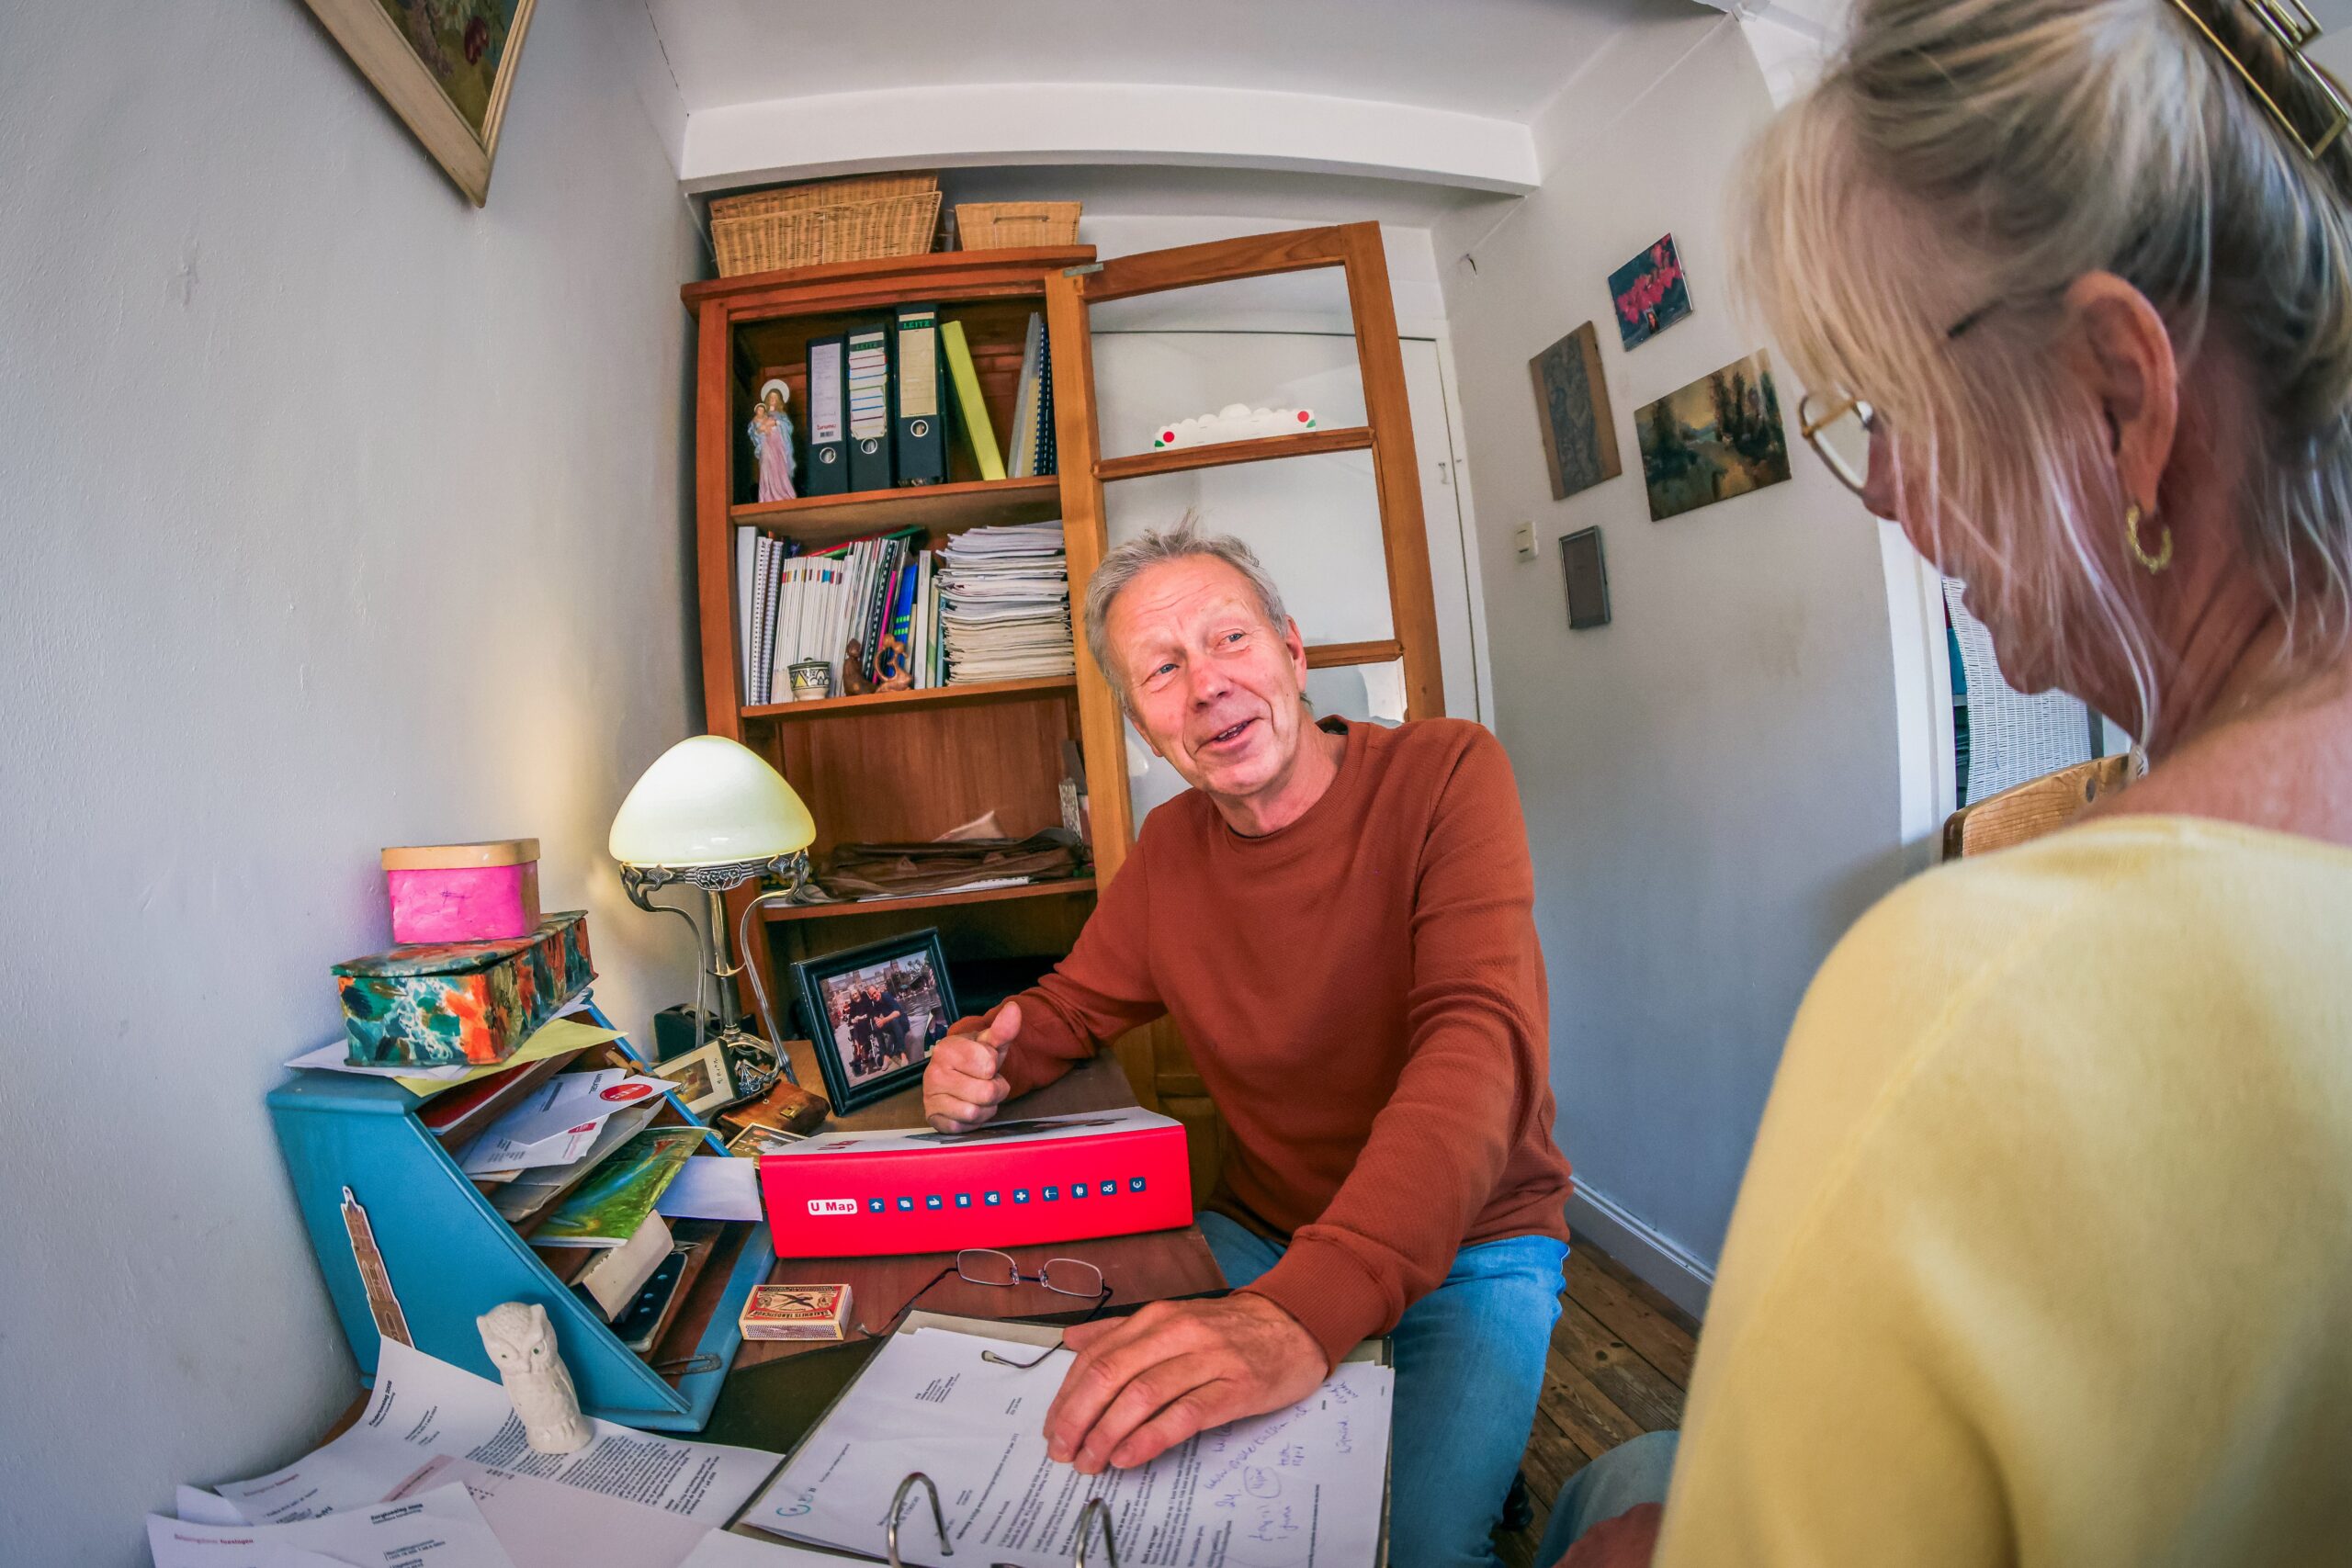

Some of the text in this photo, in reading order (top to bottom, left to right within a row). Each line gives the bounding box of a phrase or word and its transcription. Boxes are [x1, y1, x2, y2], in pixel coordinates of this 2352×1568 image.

[903, 320, 931, 329] LEITZ
[810, 1201, 854, 1213] U Map
